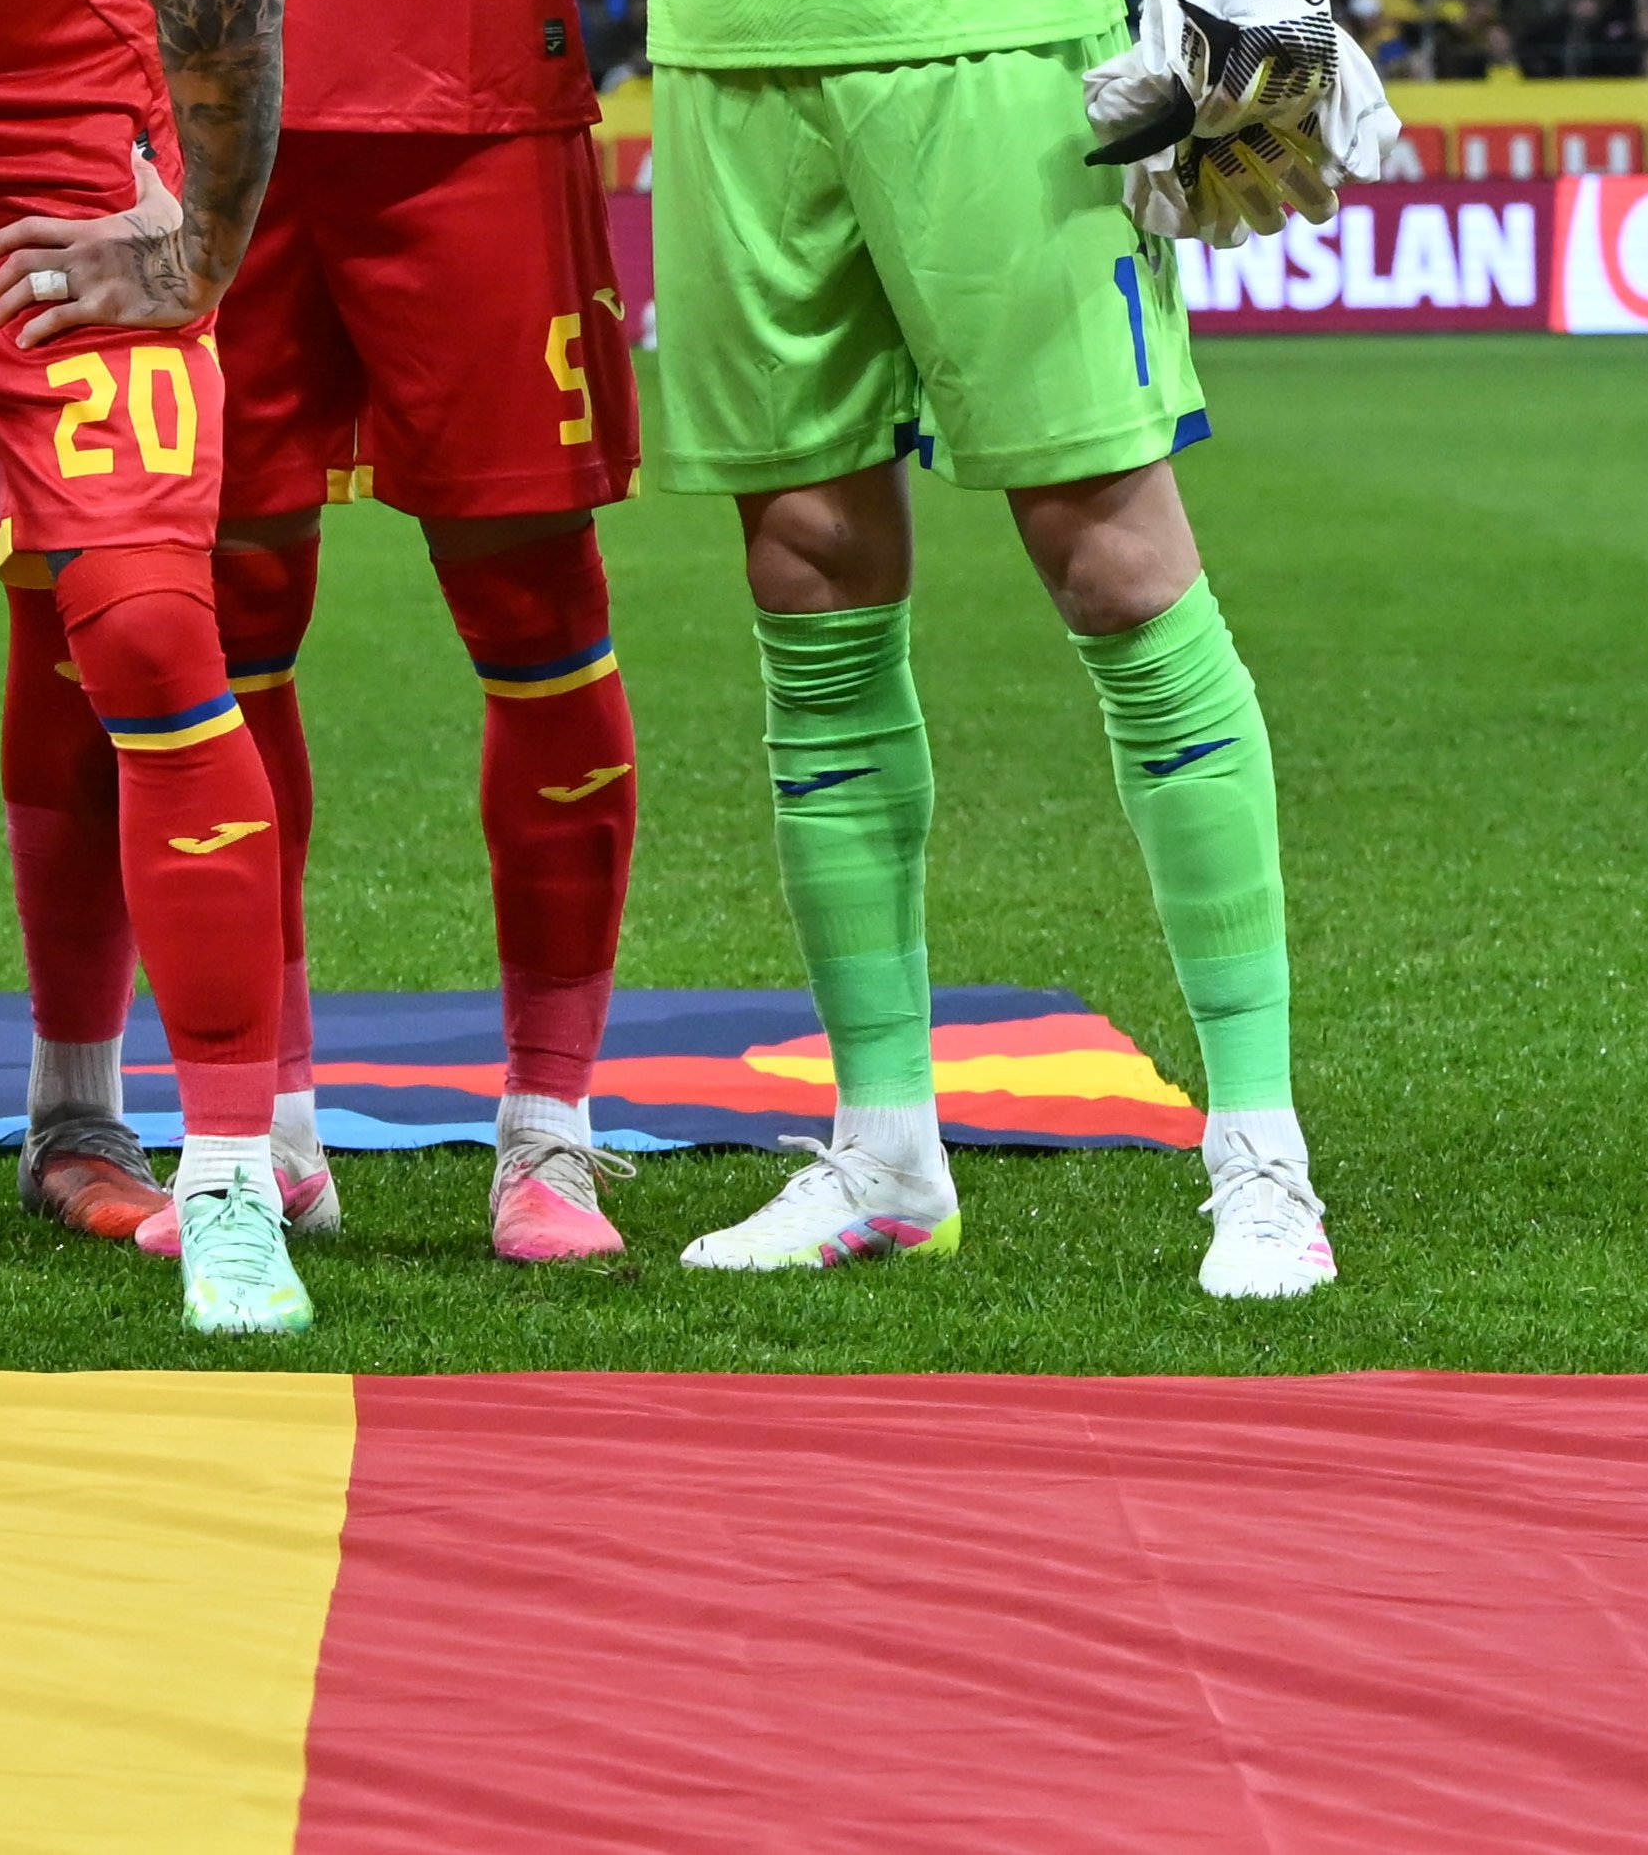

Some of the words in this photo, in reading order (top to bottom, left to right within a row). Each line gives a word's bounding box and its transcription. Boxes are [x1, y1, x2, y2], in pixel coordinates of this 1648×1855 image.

[544, 313, 593, 445] 5
[1113, 256, 1149, 387] 1
[46, 346, 197, 479] 20
